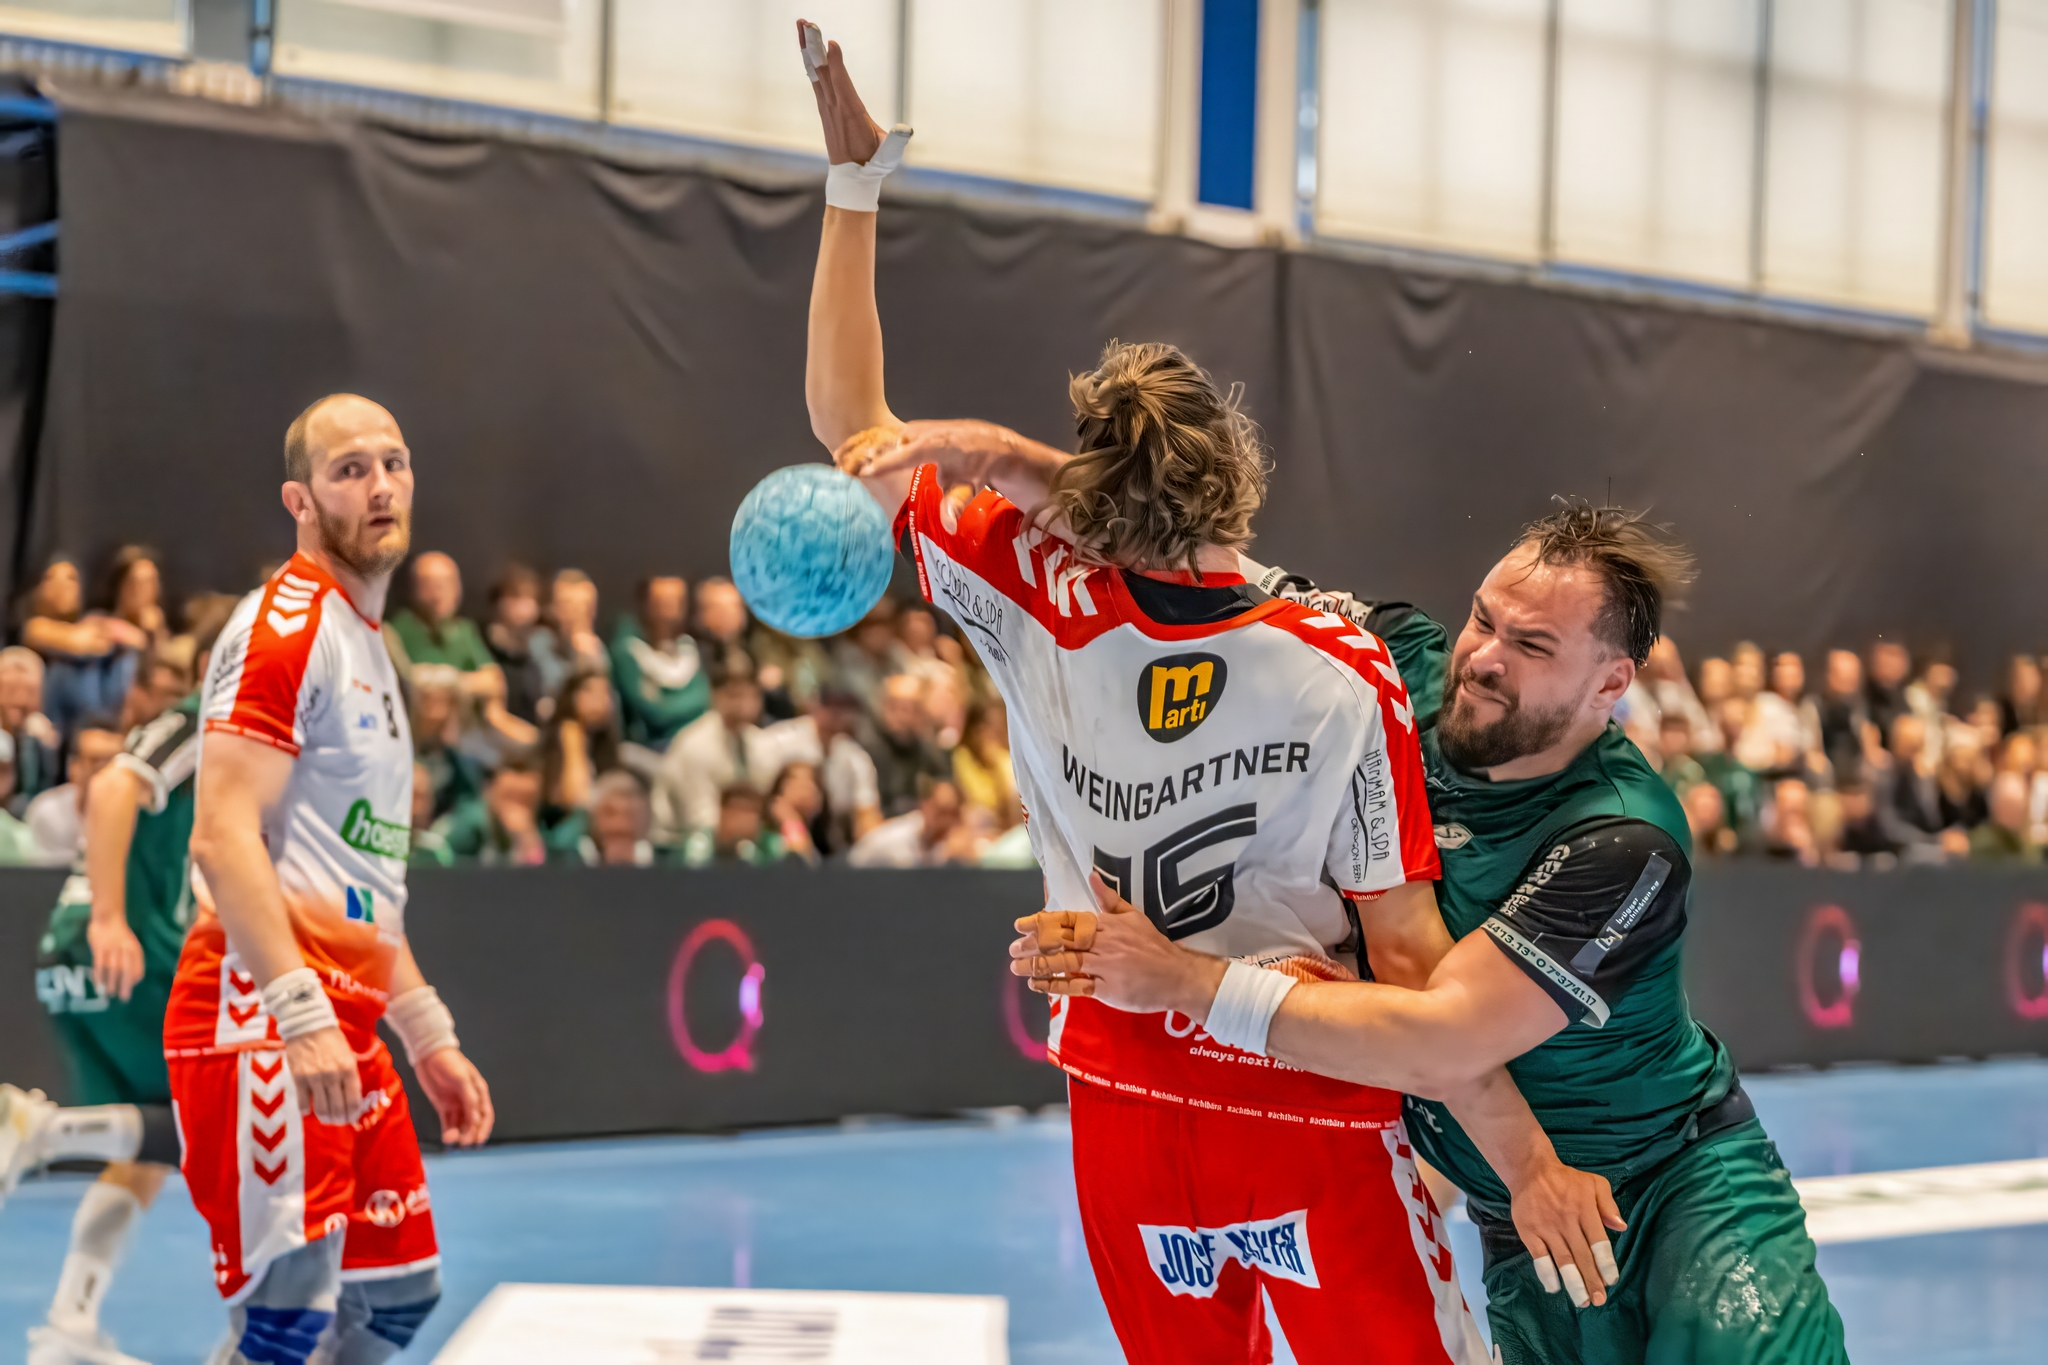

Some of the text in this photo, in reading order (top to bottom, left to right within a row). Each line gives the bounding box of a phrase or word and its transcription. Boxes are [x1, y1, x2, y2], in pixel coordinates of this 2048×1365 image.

[1062, 742, 1311, 822] WEINGARTNER
[1371, 831, 1390, 861] SPA
[1189, 1045, 1235, 1062] always
[1238, 1055, 1270, 1068] next
